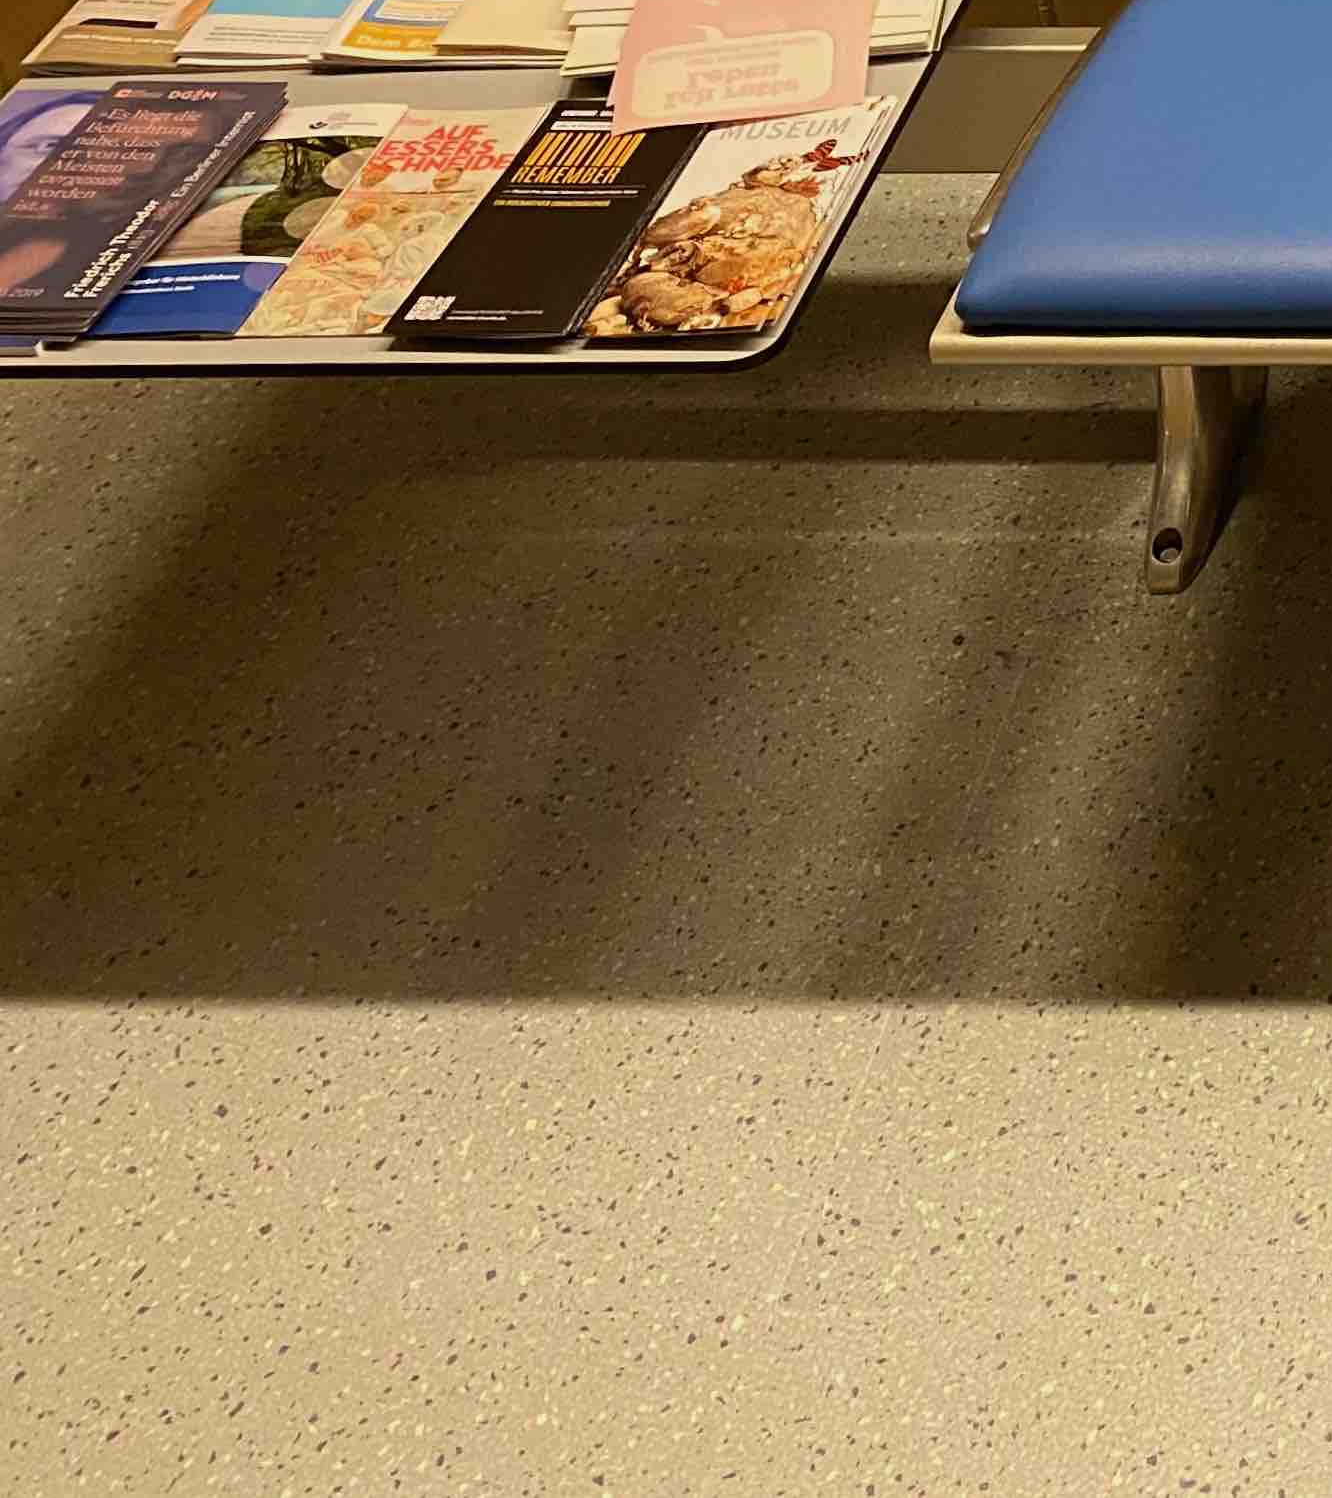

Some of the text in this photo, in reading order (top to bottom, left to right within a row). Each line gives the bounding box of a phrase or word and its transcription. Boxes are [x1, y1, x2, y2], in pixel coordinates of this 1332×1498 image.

[424, 125, 489, 141] AUF
[719, 116, 851, 141] MUSEUM
[510, 165, 622, 184] REMEMBER
